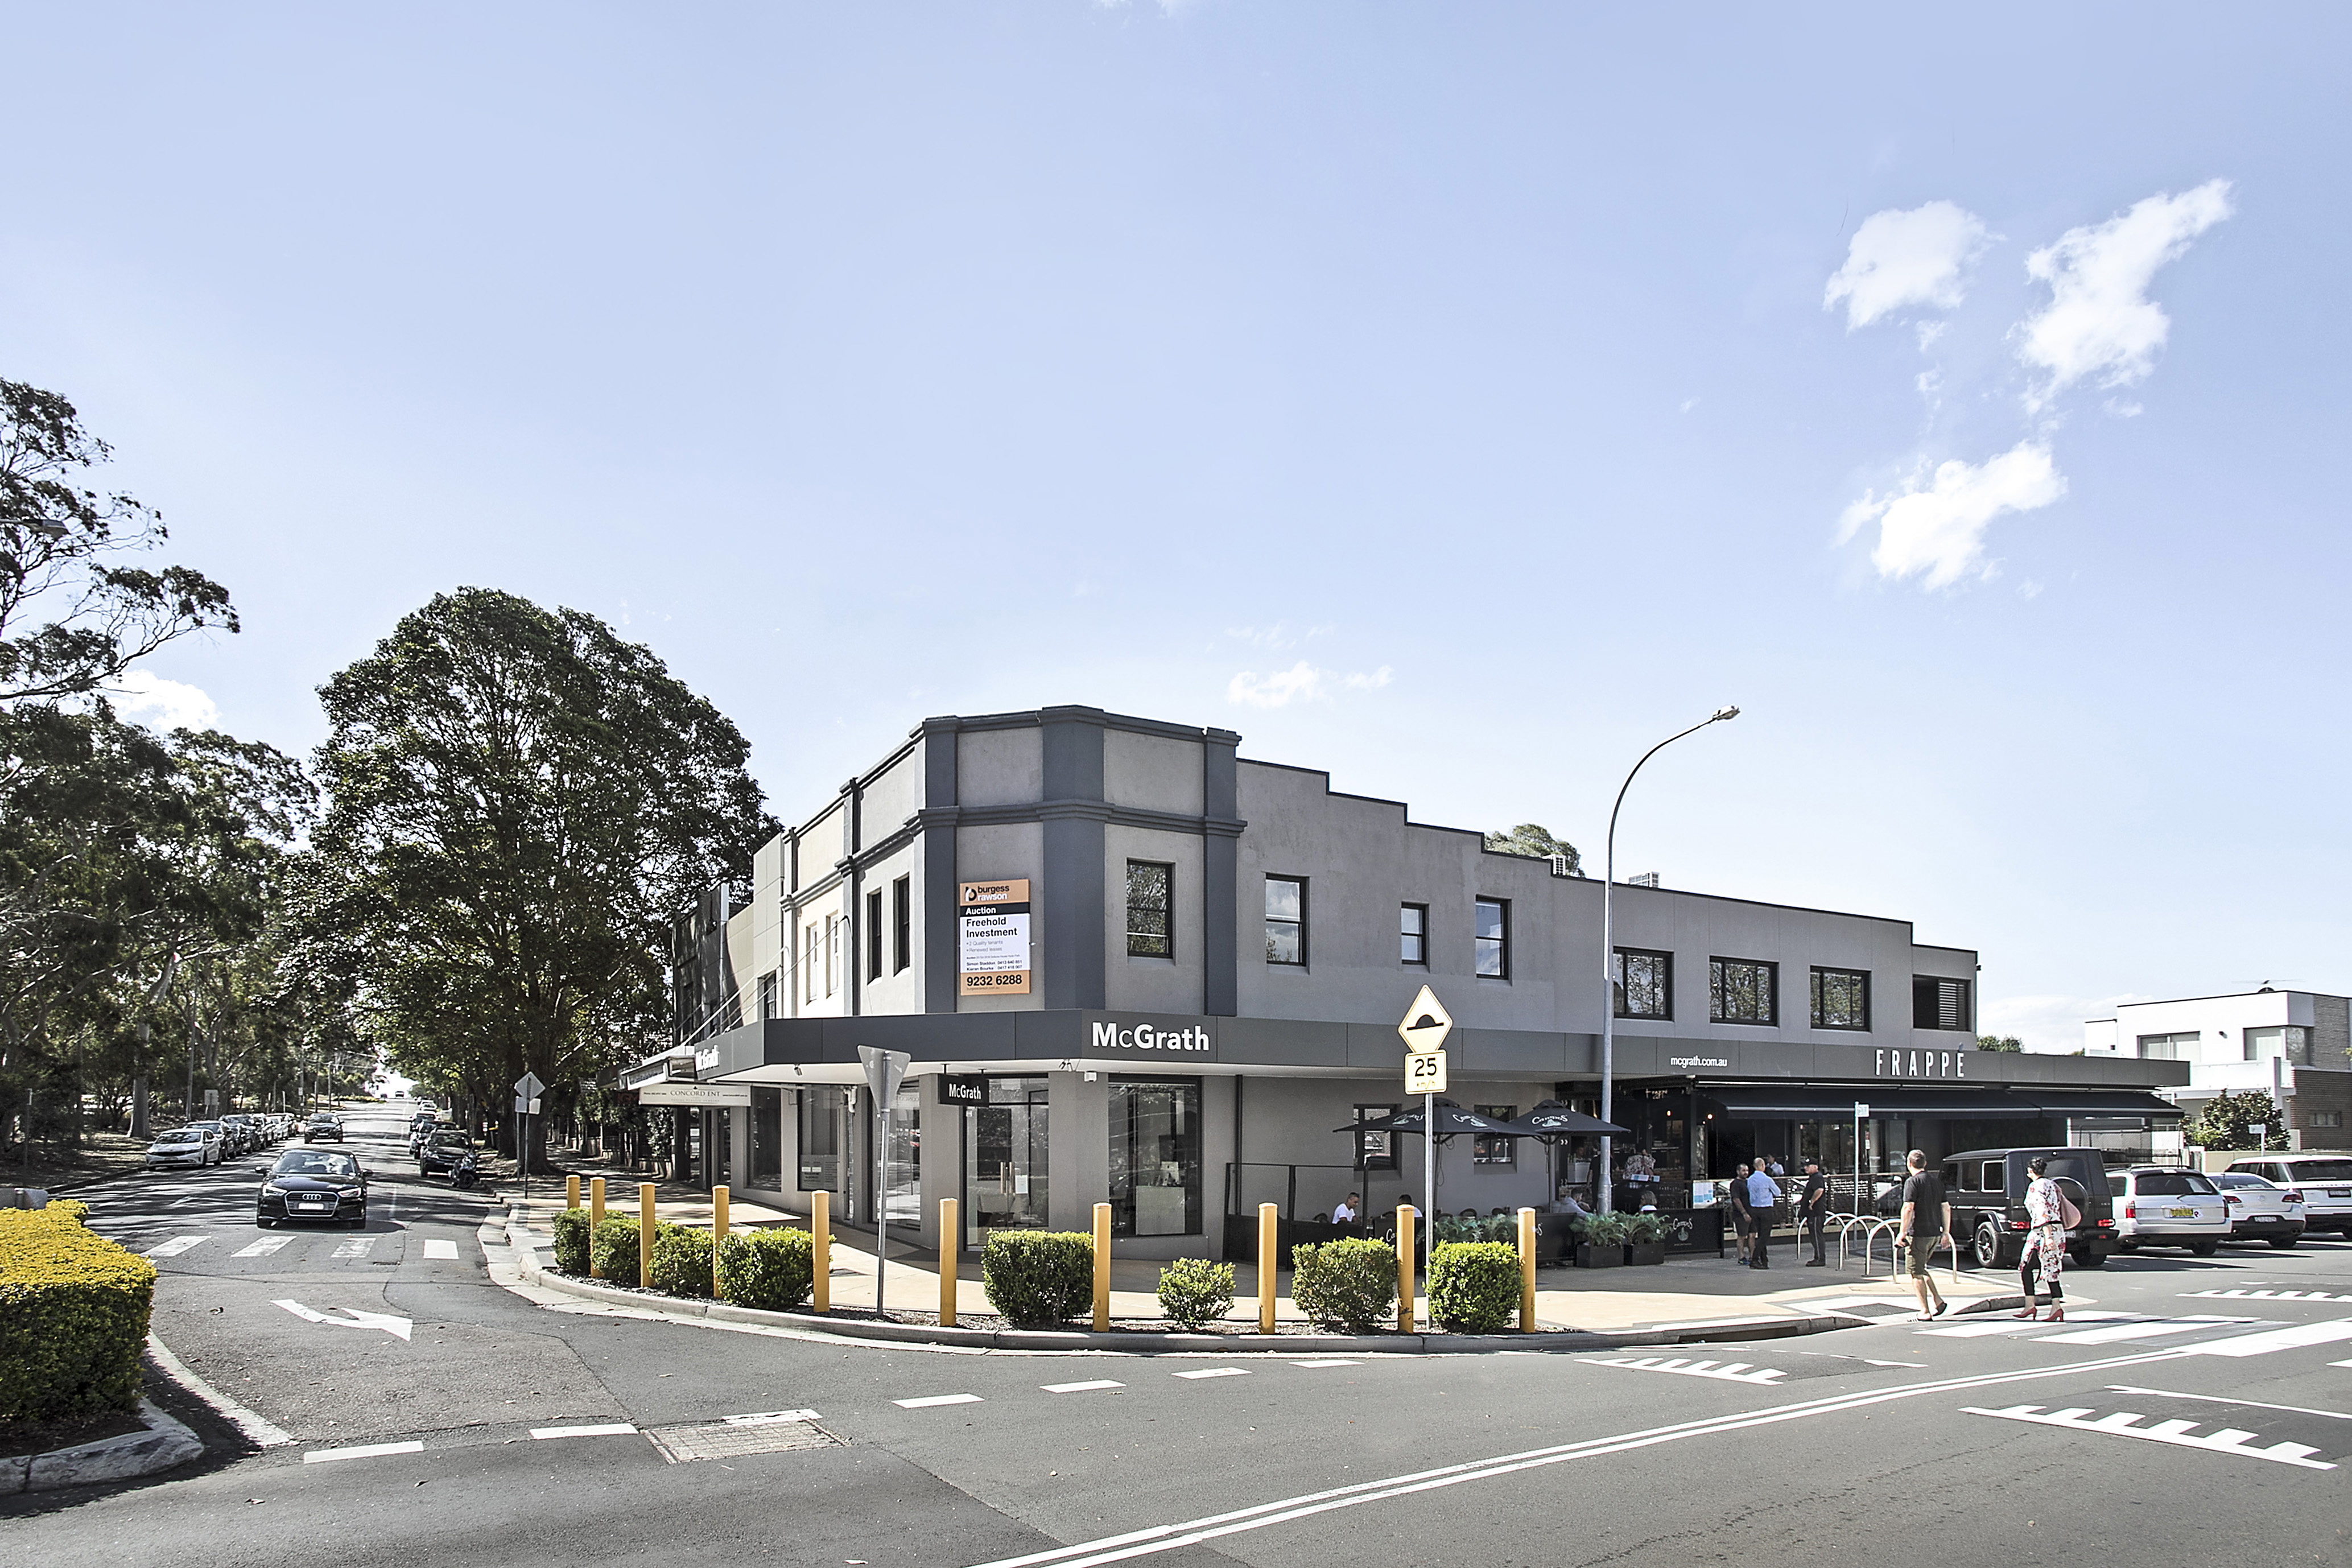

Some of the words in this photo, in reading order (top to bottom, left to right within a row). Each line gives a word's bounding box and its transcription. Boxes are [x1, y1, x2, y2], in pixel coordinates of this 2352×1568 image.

[977, 885, 1010, 894] burgess
[965, 906, 996, 915] Auction
[967, 917, 1006, 927] Freehold
[967, 927, 1017, 938] Investment
[967, 976, 993, 987] 9232
[996, 975, 1022, 985] 6288
[1092, 1022, 1209, 1051] McGrath
[1415, 1057, 1437, 1076] 25
[1670, 1055, 1727, 1068] mcgrath.com.au
[949, 1084, 981, 1099] McGrath
